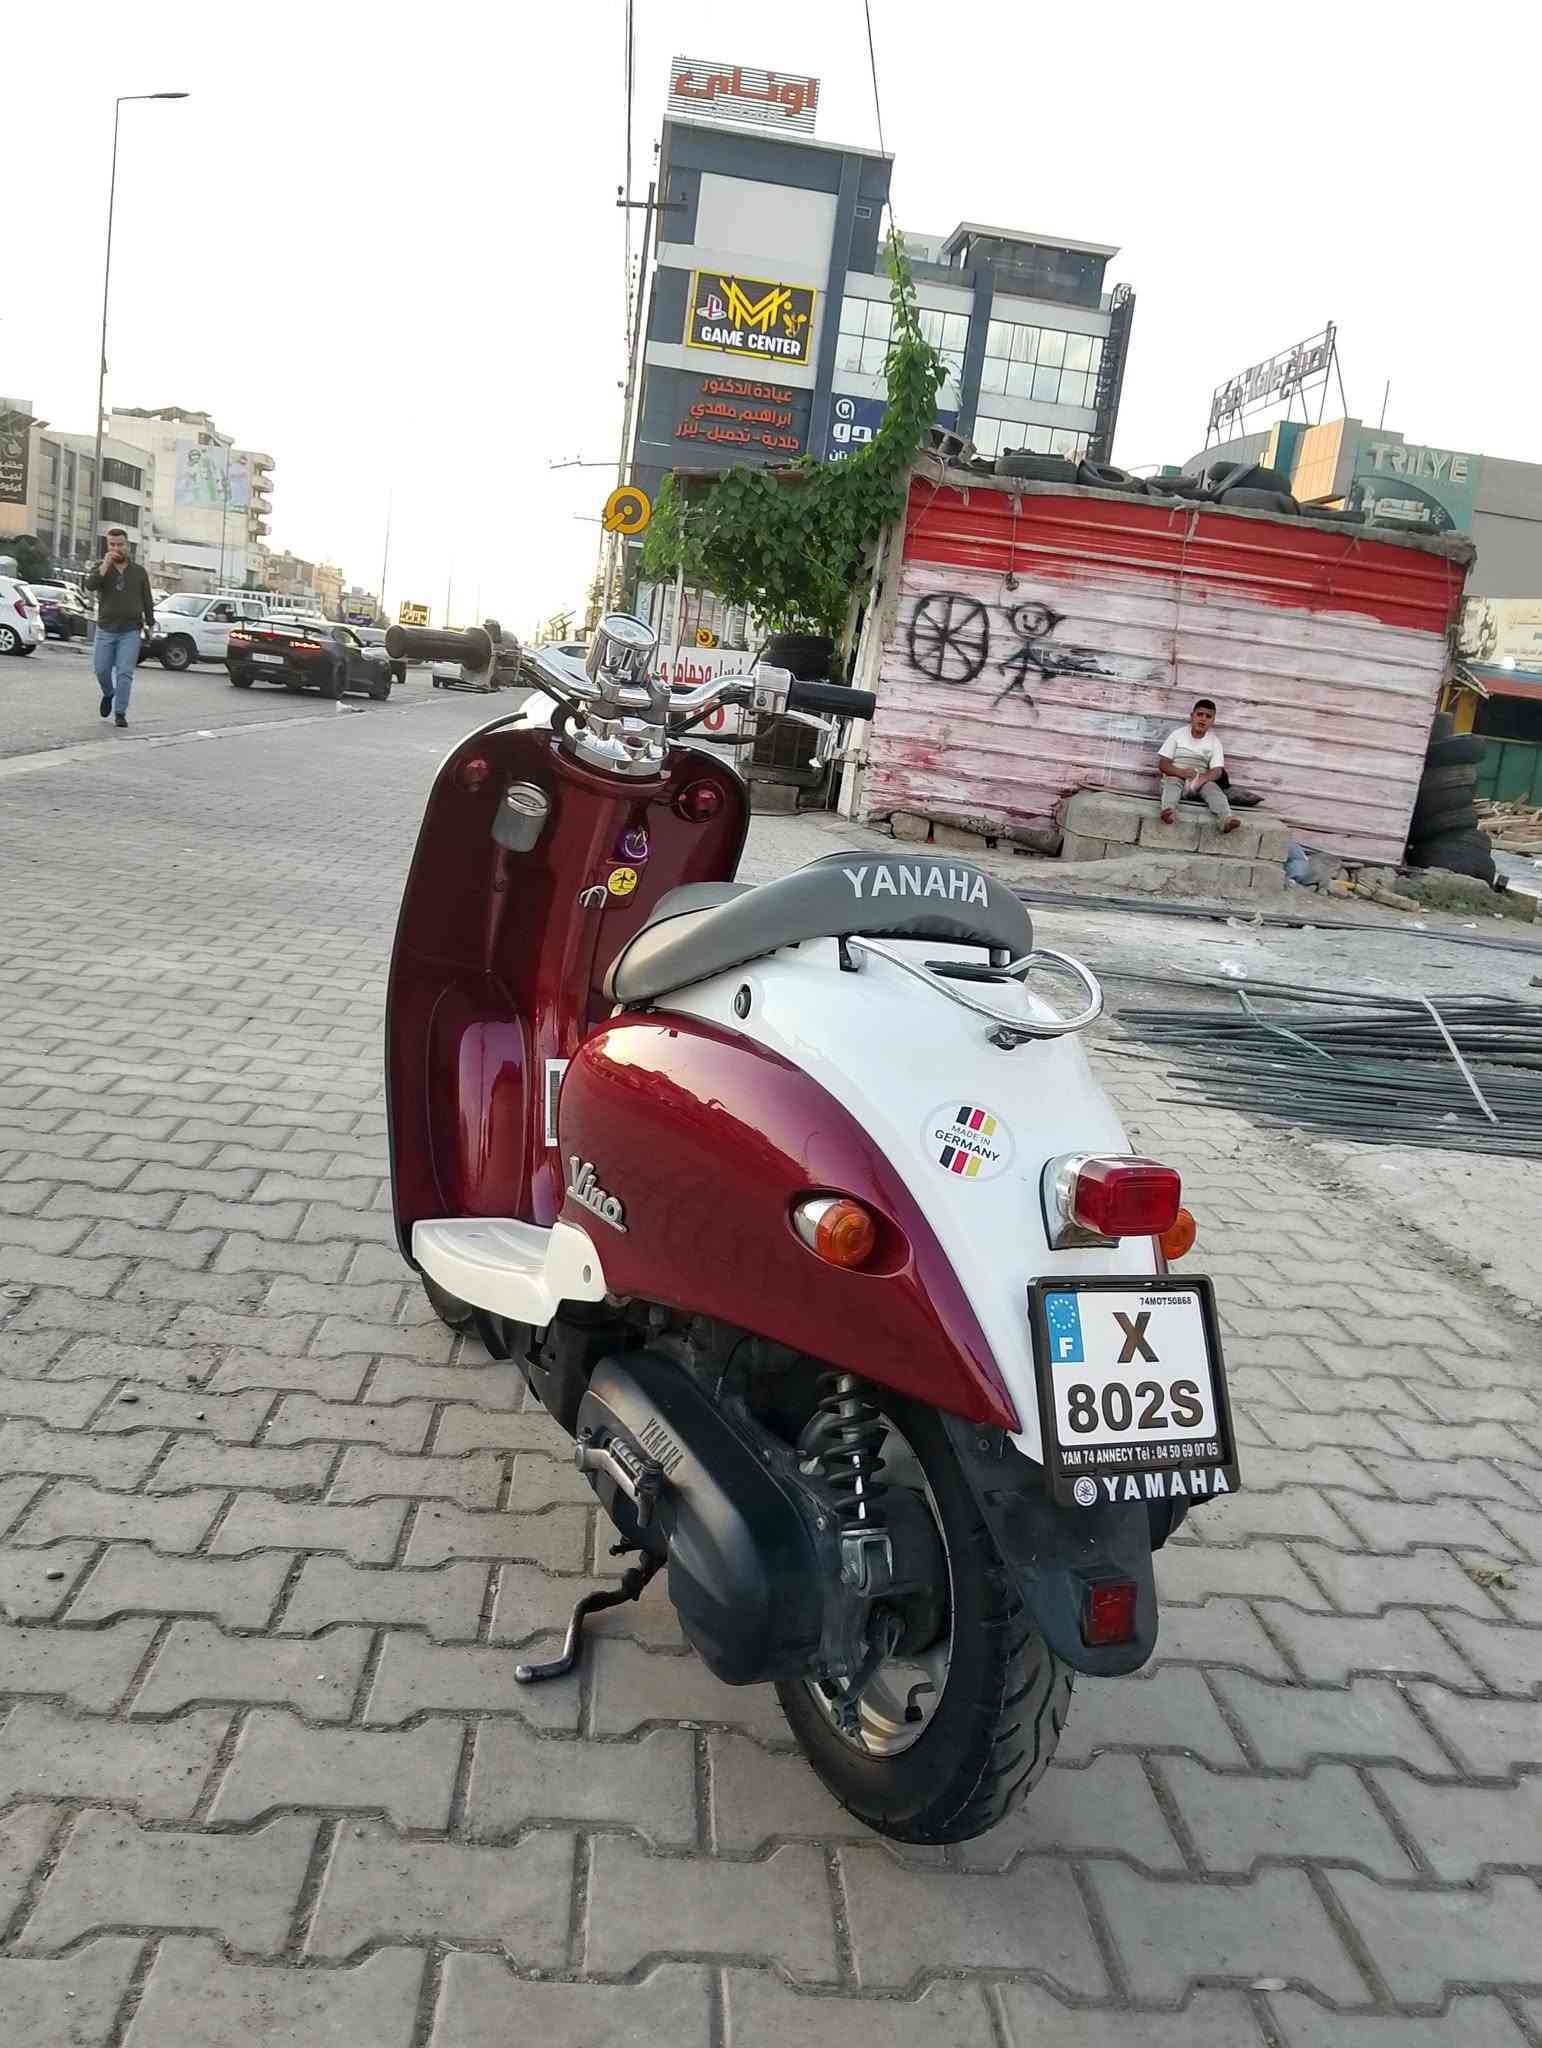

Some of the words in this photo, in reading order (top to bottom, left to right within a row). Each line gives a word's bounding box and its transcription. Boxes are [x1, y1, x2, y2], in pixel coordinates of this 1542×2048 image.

[701, 326, 744, 347] GAME
[747, 333, 801, 356] CENTER
[702, 377, 753, 397] الدكتور
[753, 384, 793, 404] عيادة
[706, 426, 751, 444] تجميل
[761, 430, 800, 451] جلدية
[843, 864, 989, 908] YANAHA
[935, 1129, 1000, 1162] GERMANY
[951, 1125, 979, 1140] MADE
[980, 1136, 991, 1146] IN
[566, 1155, 629, 1232] Vino
[1059, 1337, 1074, 1359] F
[1112, 1311, 1159, 1364] X
[1067, 1379, 1205, 1434] 802S
[639, 1417, 685, 1476] YAMAHA
[1061, 1450, 1081, 1466] YAM
[1083, 1450, 1095, 1465] 74
[1096, 1447, 1133, 1464] ANNECY
[1156, 1445, 1168, 1459] 04
[1169, 1443, 1181, 1459] 50
[1182, 1443, 1194, 1458] 69
[1194, 1442, 1205, 1457] 07
[1101, 1467, 1230, 1503] YAMAHA
